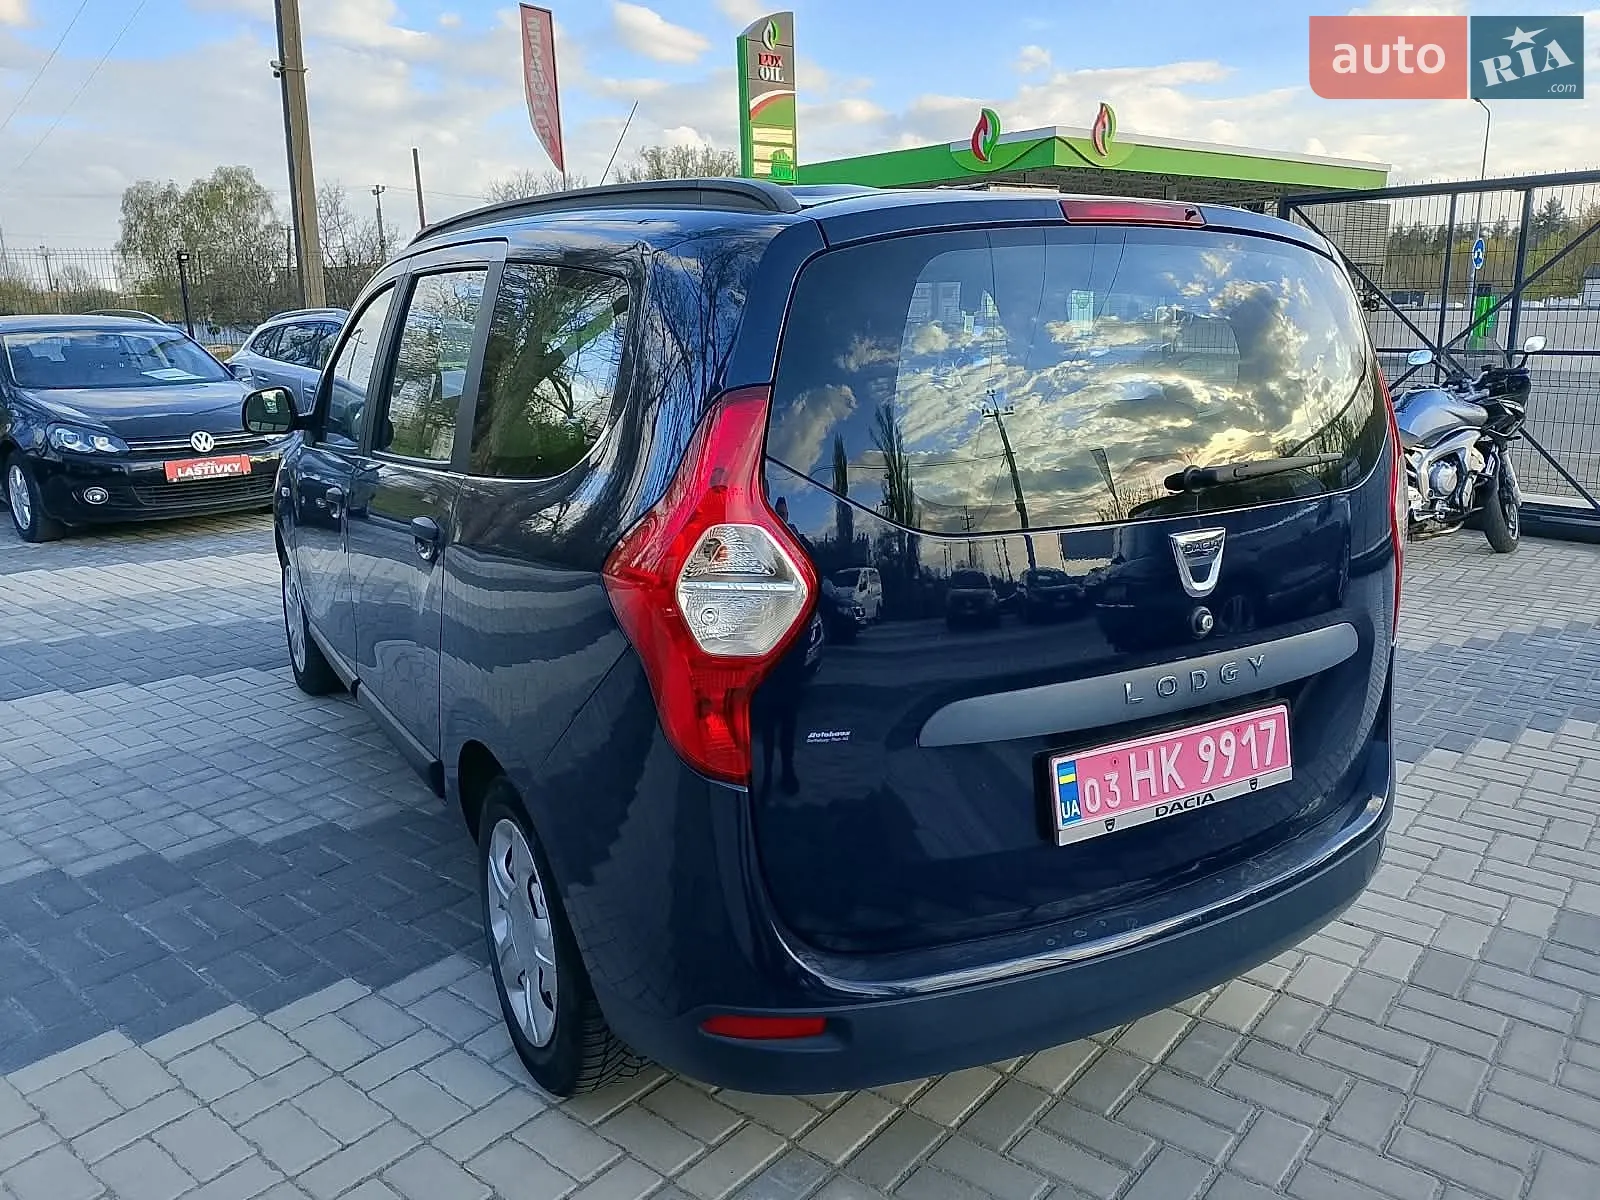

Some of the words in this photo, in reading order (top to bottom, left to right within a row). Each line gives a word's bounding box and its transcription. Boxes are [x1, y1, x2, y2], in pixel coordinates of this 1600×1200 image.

[759, 66, 784, 82] OIL
[1124, 654, 1265, 704] LODGY
[1062, 800, 1081, 818] UA
[1155, 792, 1216, 818] DACIA
